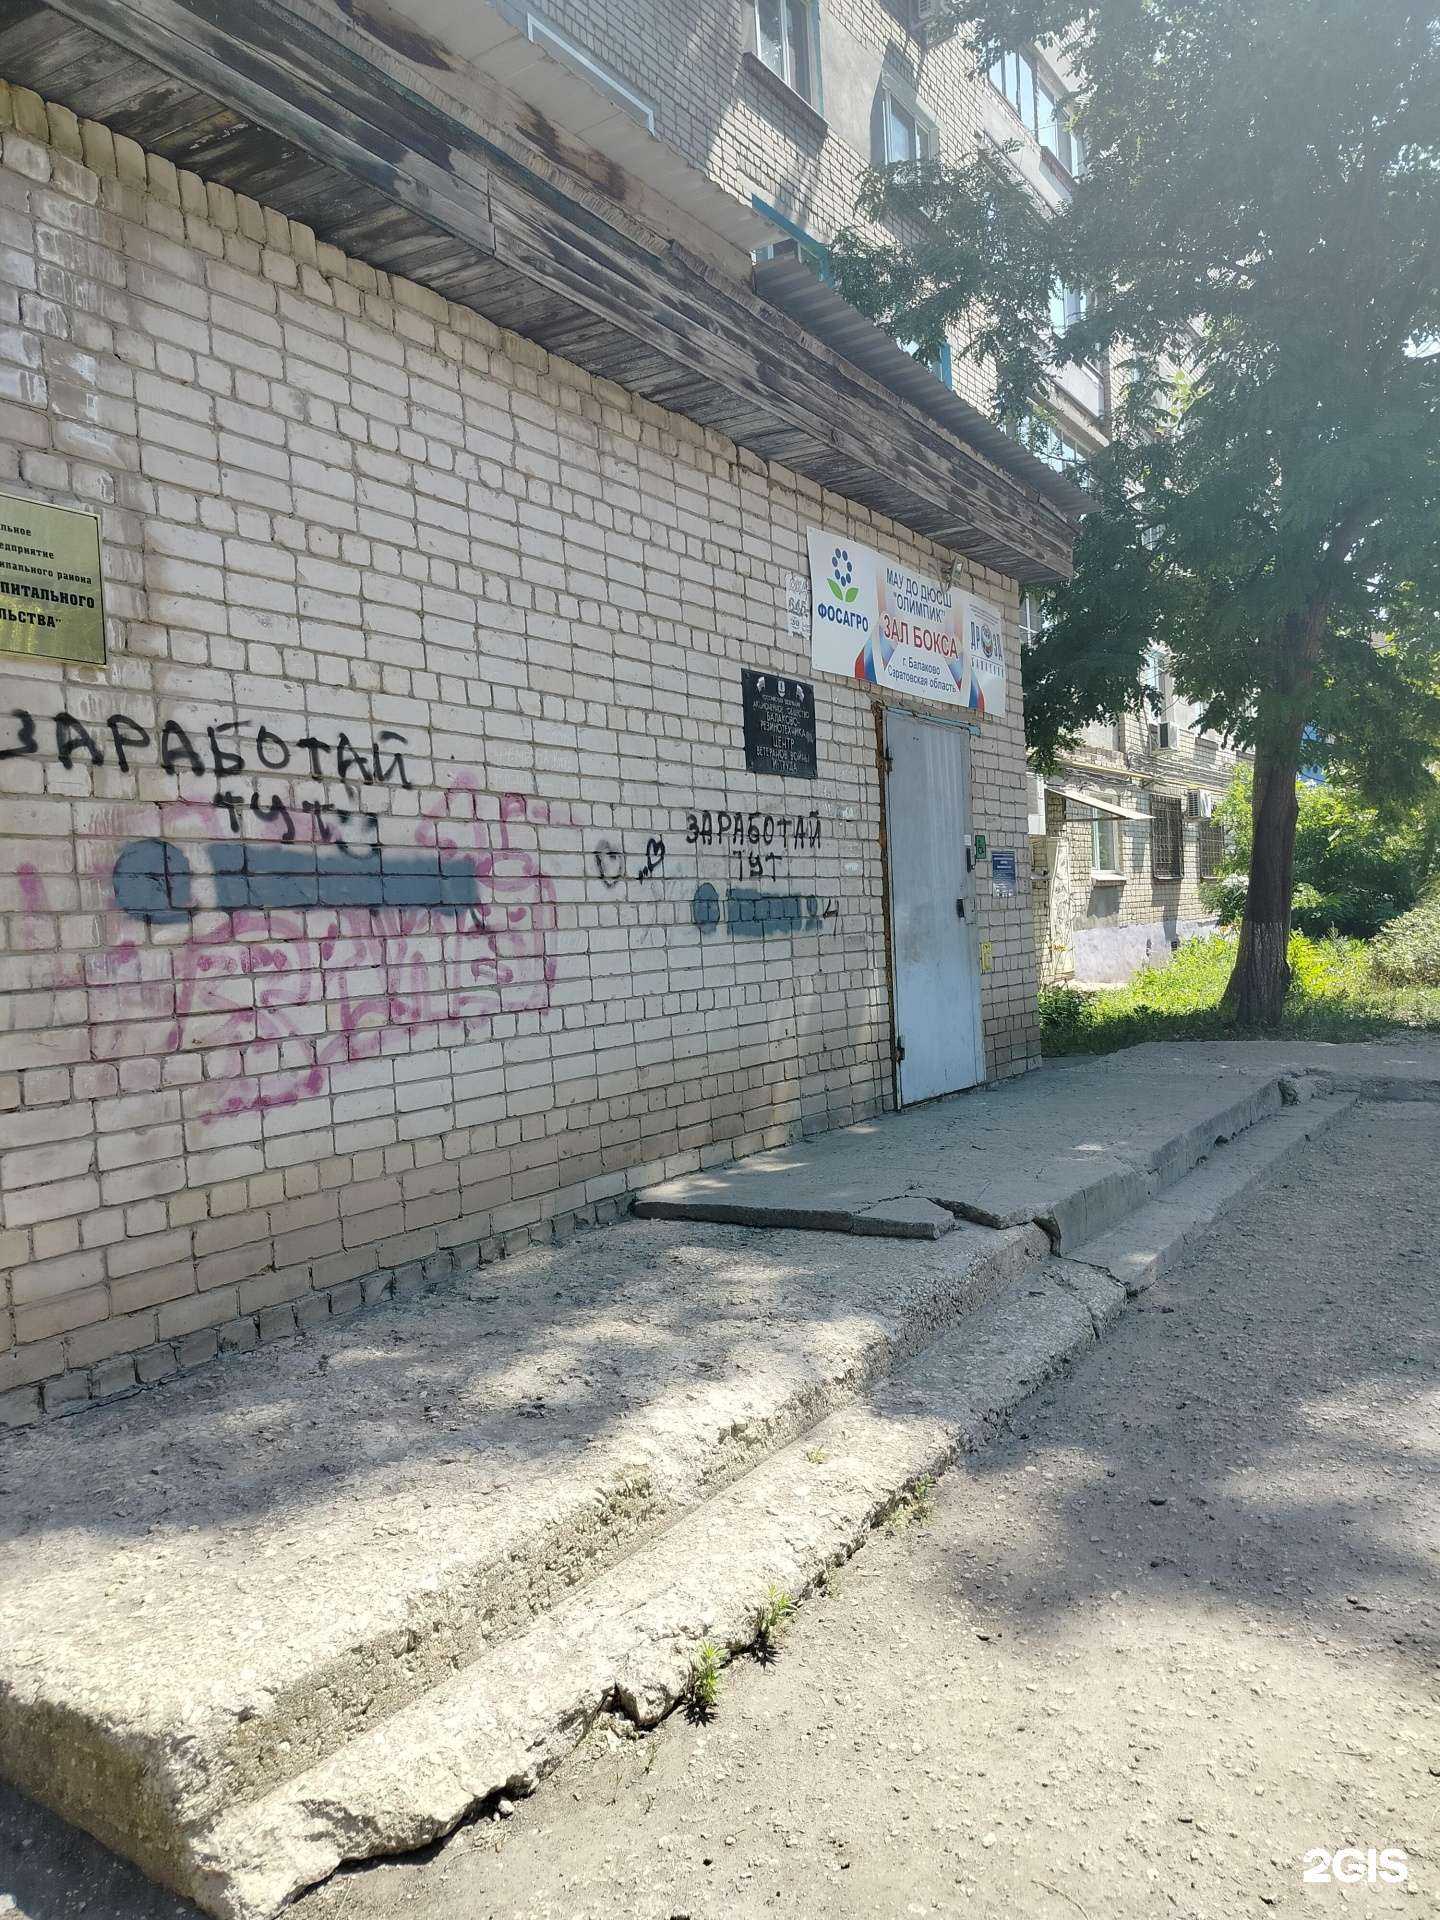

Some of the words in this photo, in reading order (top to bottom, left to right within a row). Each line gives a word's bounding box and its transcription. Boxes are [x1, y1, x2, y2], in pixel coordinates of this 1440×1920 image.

[886, 567, 904, 590] МАУ
[906, 577, 919, 598] ДО
[817, 602, 869, 633] ФОСАГРО
[883, 614, 909, 645] ЗАЛ
[913, 625, 959, 660] БОКСА
[887, 664, 929, 687] Саратовская
[908, 656, 941, 676] Балаково
[0, 709, 413, 790] ЗАРАБОТАЙ
[685, 809, 822, 849] ЗАРАБОТАЙ
[732, 850, 783, 882] ТУТ
